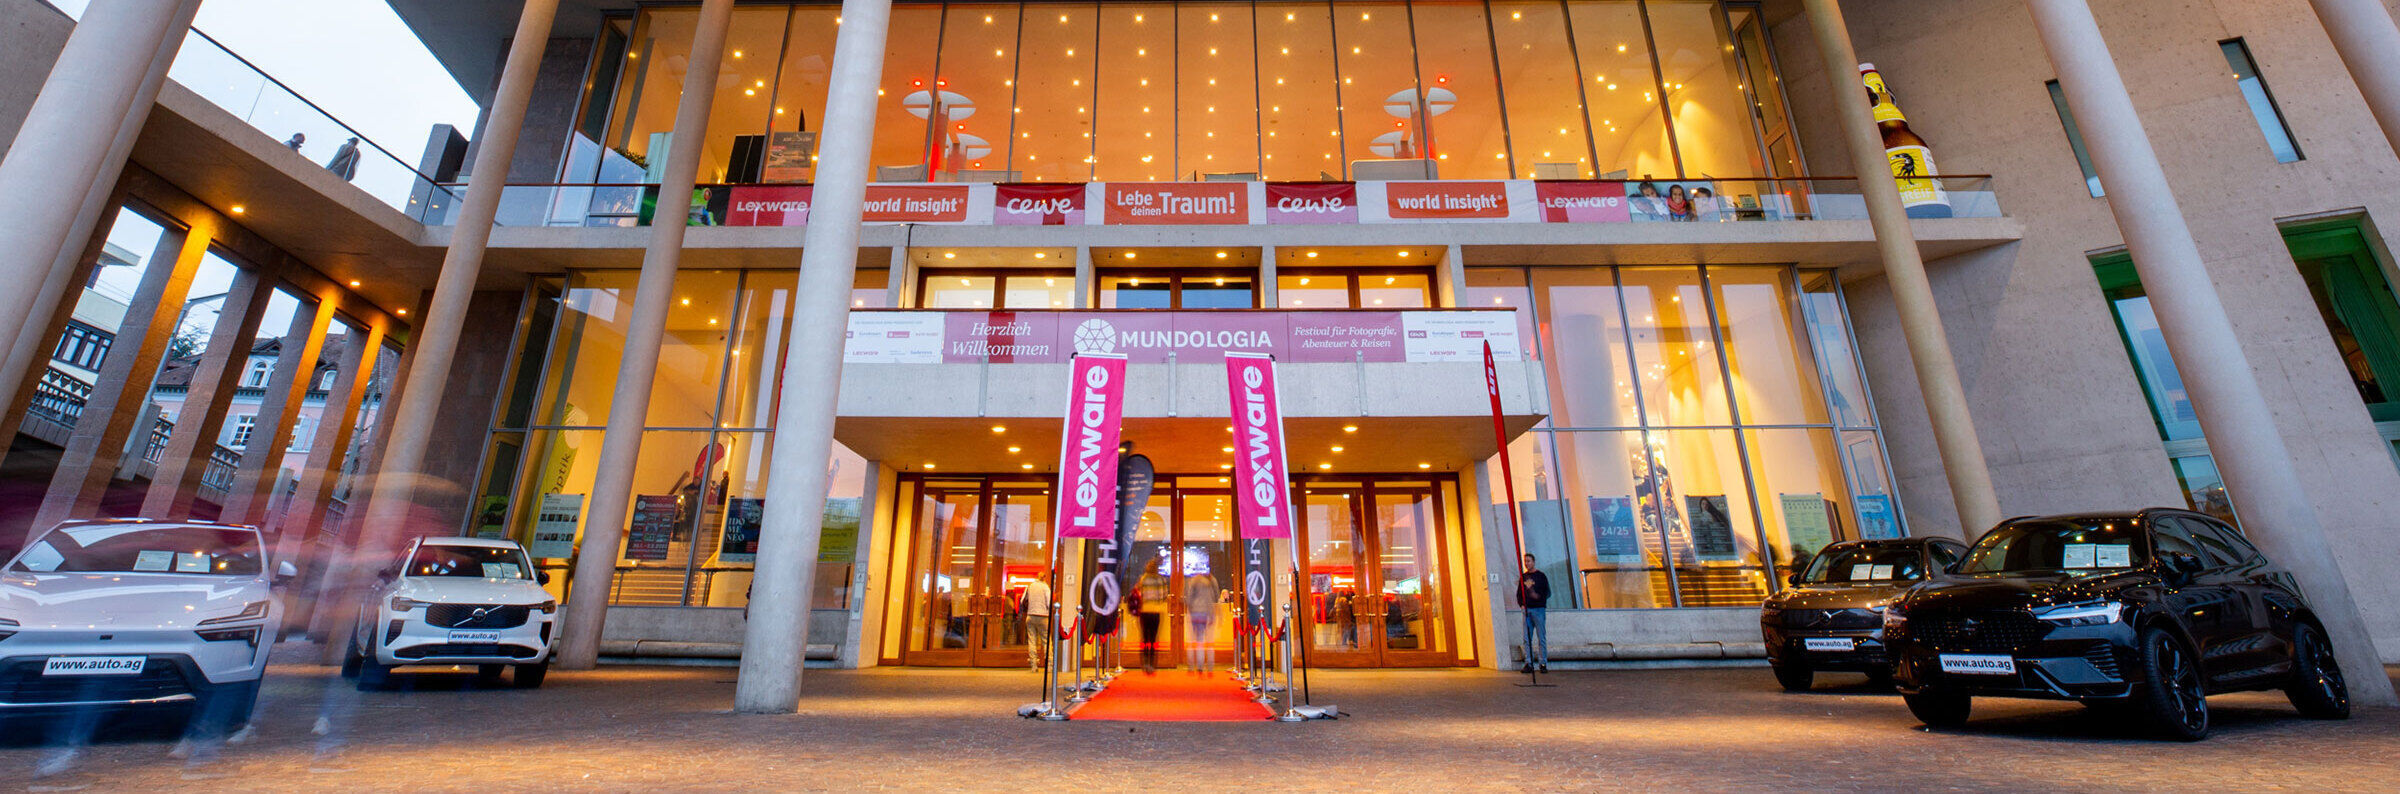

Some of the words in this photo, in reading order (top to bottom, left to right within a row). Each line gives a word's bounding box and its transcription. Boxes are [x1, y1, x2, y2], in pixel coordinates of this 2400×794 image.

[1117, 190, 1152, 206] Lebe
[1397, 194, 1440, 209] world
[1545, 196, 1619, 208] Lexware
[1900, 188, 1931, 201] REIF
[736, 200, 808, 212] Lexware
[863, 197, 901, 213] world
[1006, 197, 1074, 215] cewe
[1131, 206, 1162, 216] deinen
[1159, 191, 1236, 214] Traum!
[1277, 196, 1346, 213] cewe
[971, 322, 1031, 336] Herzlich
[1294, 326, 1330, 336] Festival
[1330, 326, 1346, 338] für
[1348, 325, 1397, 338] Fotografie,
[1121, 330, 1273, 348] MUNDOLOGIA
[1302, 338, 1349, 348] Abenteuer
[1350, 338, 1359, 348] &
[1360, 338, 1391, 348] Reisen
[952, 340, 1049, 356] Willkommen
[1074, 365, 1109, 527] Lexware
[1243, 365, 1278, 527] Lexware
[1600, 526, 1629, 536] 24/25
[50, 659, 142, 670] www.auto.ag
[1943, 659, 2012, 670] www.auto.ag
